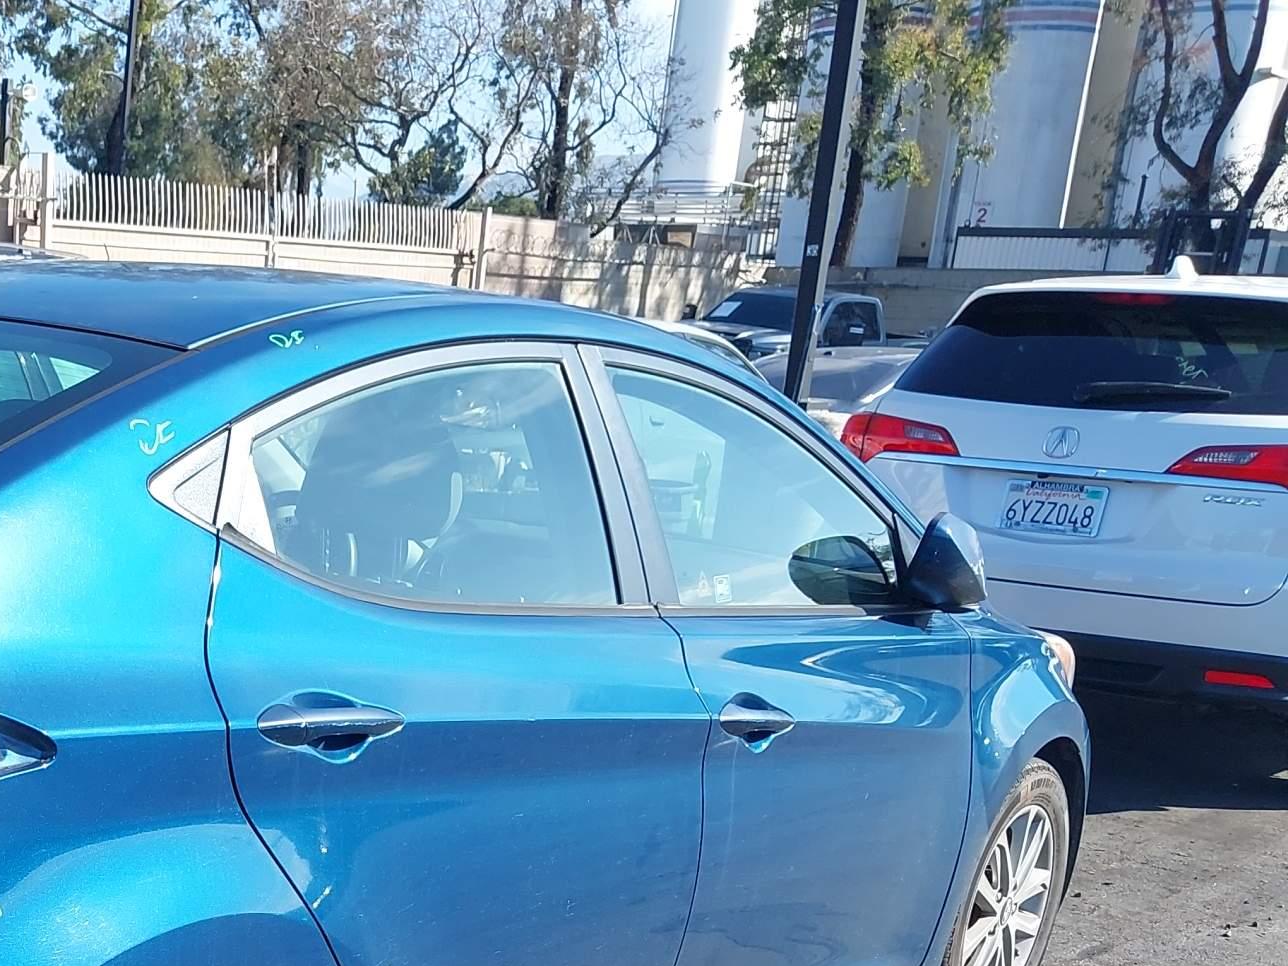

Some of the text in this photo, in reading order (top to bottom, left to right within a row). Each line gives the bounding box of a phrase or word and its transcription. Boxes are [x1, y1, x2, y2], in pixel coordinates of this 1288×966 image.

[976, 207, 987, 223] 2
[1032, 481, 1081, 493] ALHAMBRA
[1005, 498, 1095, 528] 6YZZ048
